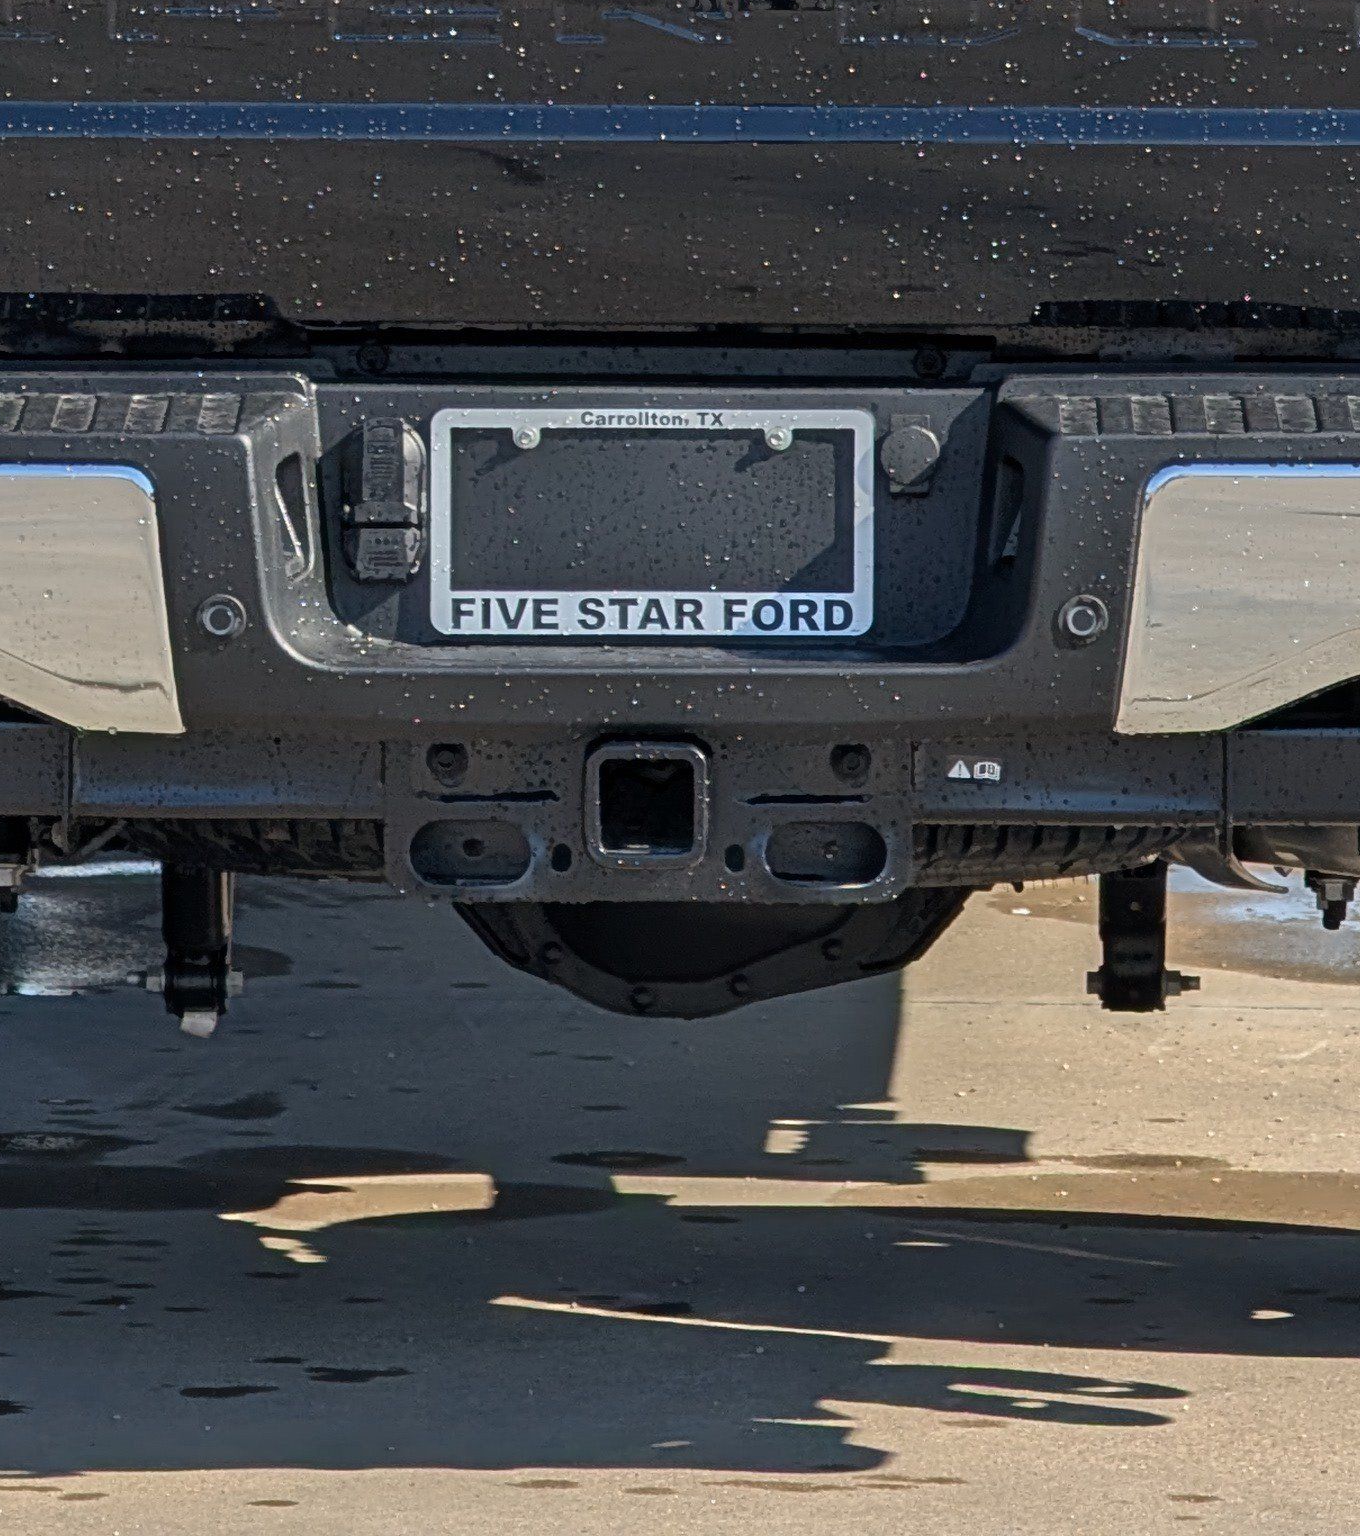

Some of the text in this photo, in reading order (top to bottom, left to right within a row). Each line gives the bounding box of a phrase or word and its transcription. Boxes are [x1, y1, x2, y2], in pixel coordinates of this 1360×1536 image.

[581, 412, 722, 427] Carrollton, TX
[452, 598, 853, 631] FIVE STAR FORD
